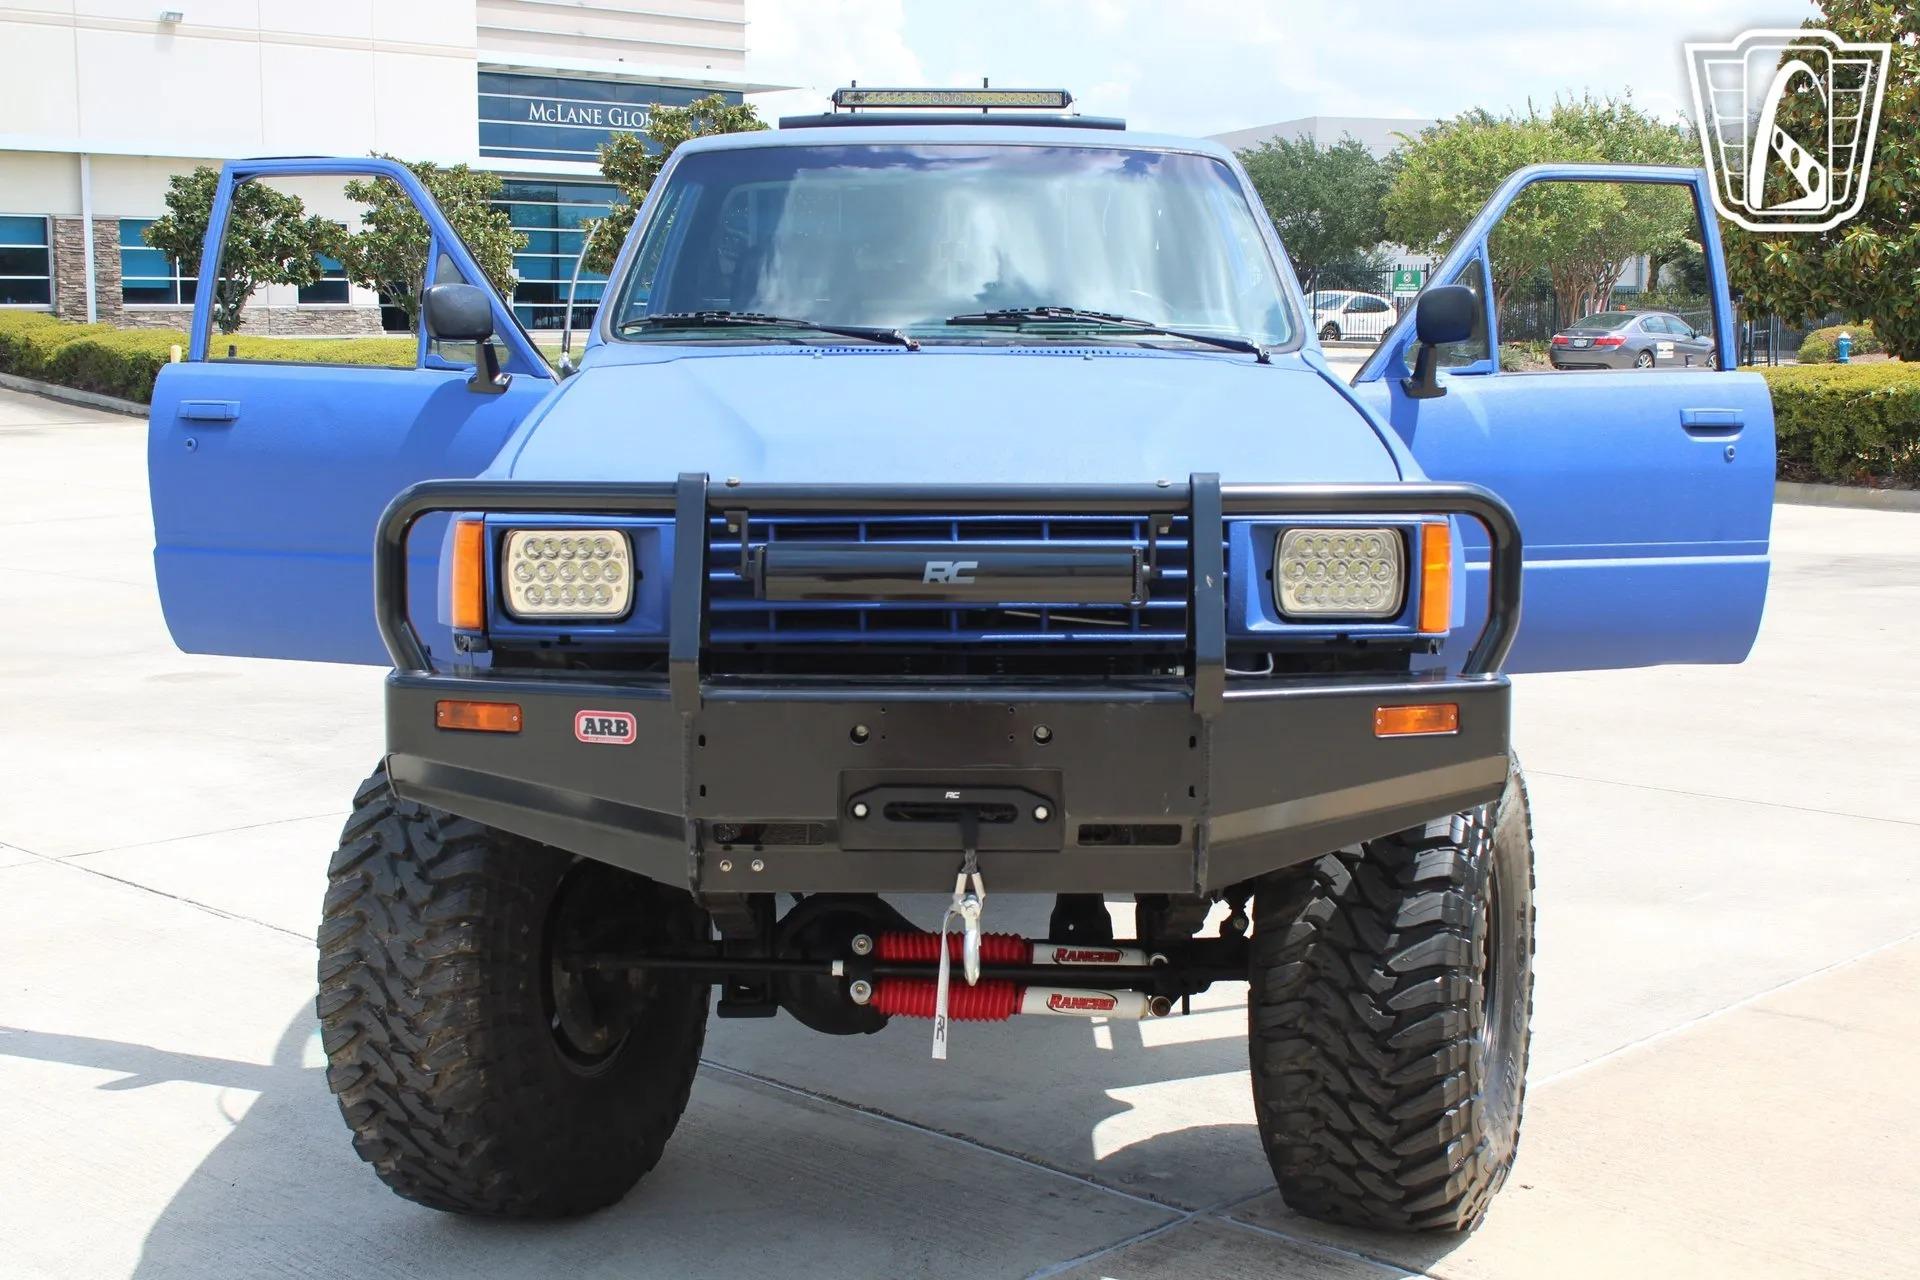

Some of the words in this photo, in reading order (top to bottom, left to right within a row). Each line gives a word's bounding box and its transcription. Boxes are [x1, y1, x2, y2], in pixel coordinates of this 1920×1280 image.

[922, 561, 978, 584] RC
[583, 717, 629, 736] ARB
[945, 791, 960, 799] RC
